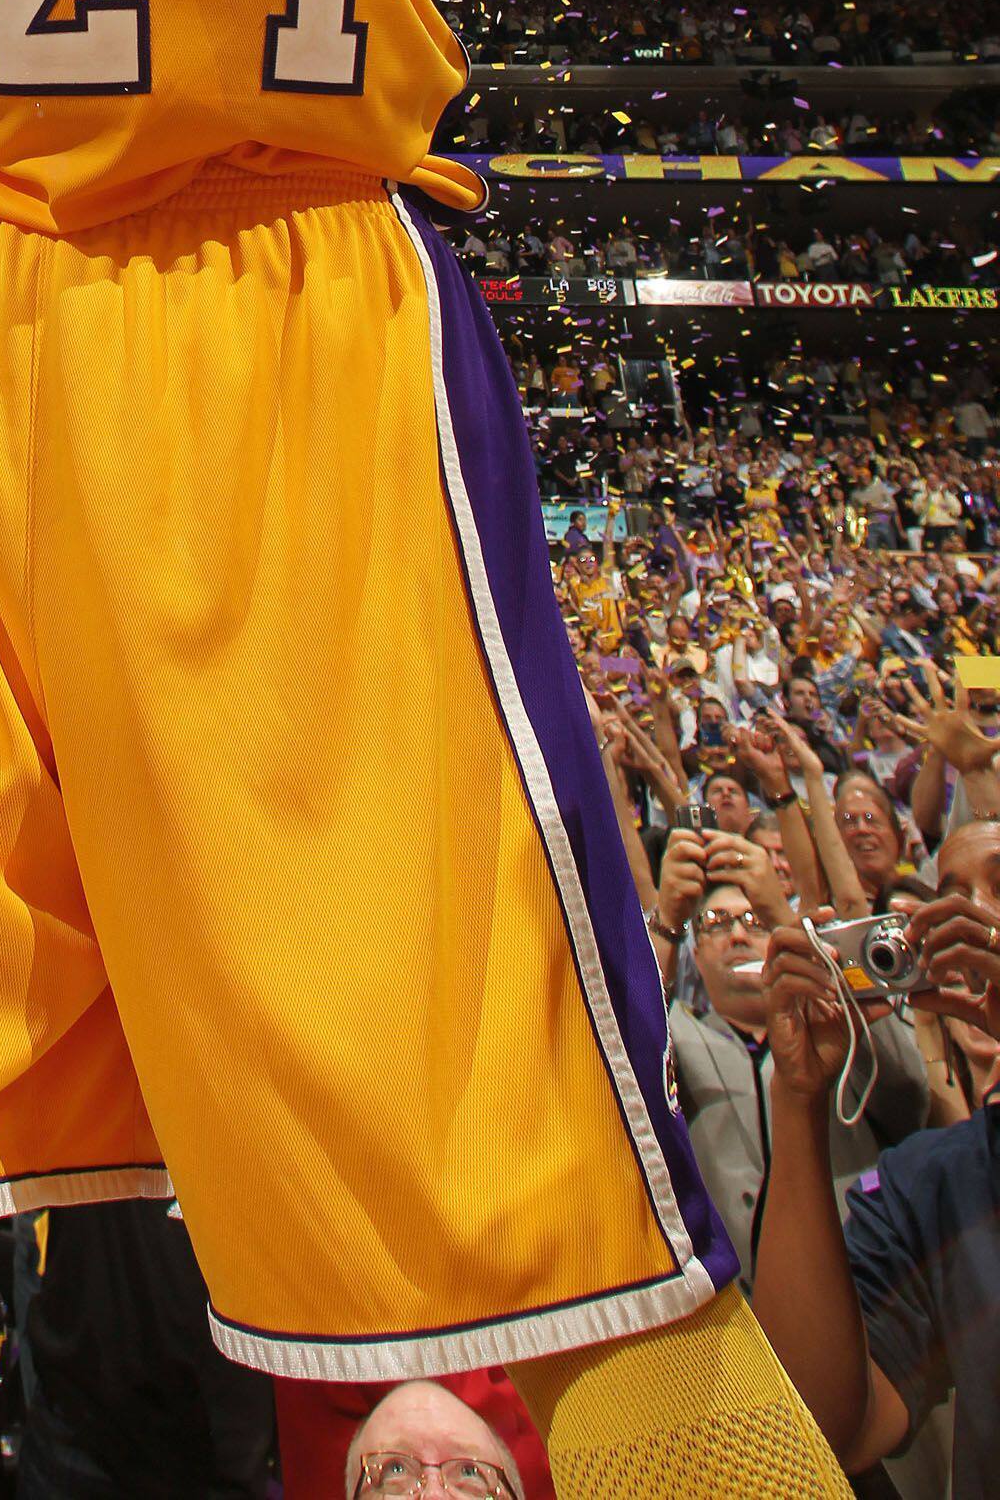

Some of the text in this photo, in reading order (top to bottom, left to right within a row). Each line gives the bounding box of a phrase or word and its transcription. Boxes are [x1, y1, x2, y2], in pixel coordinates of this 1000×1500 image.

[550, 278, 570, 291] LA
[757, 283, 872, 306] TOYOTA
[890, 285, 999, 310] LAKERS
